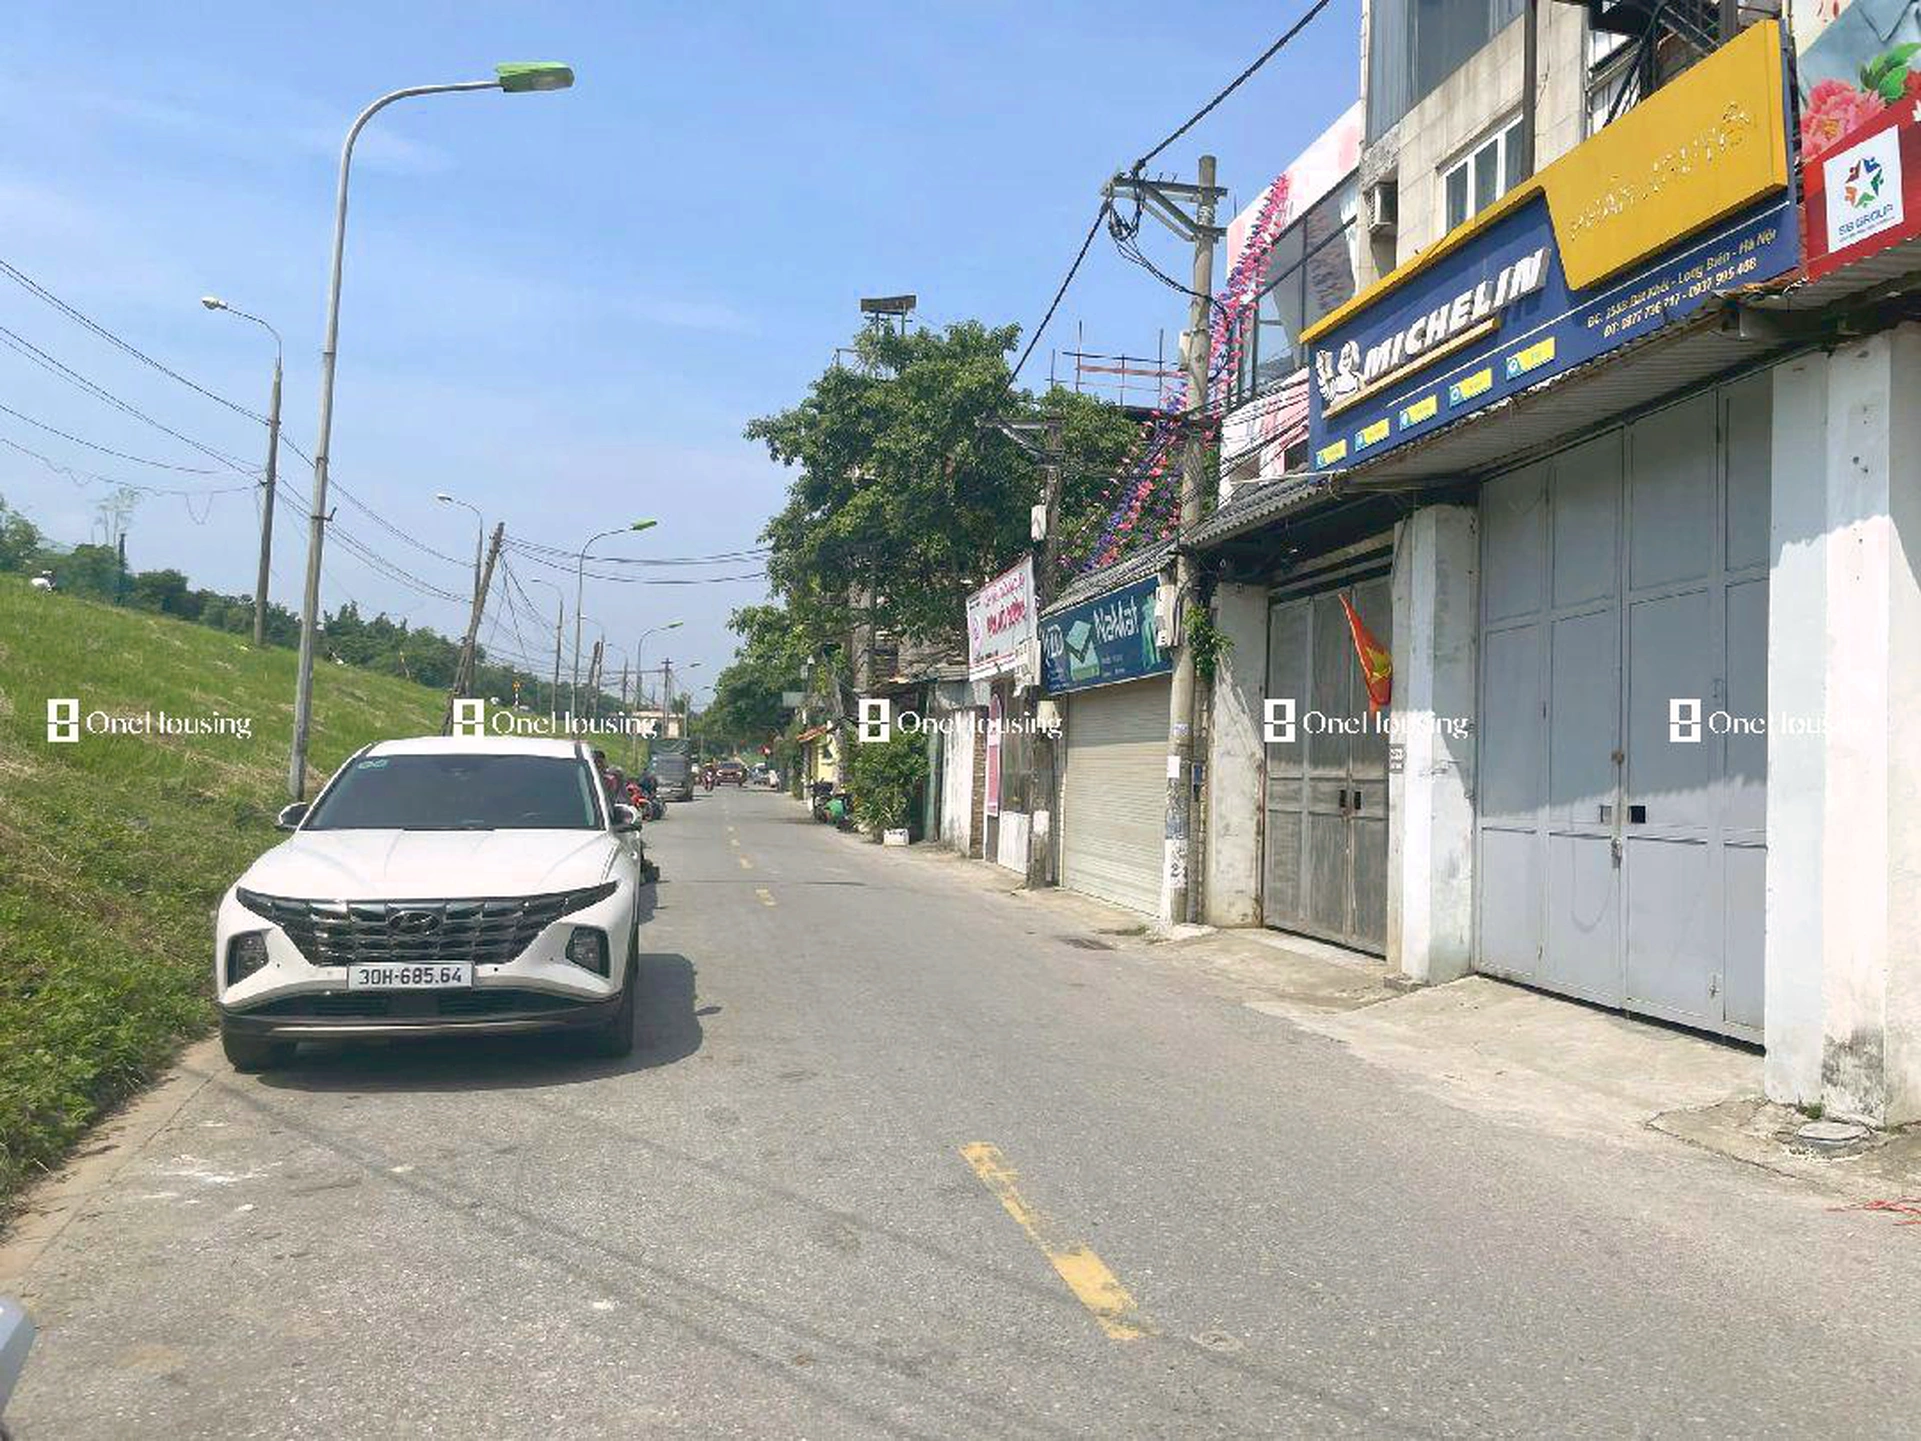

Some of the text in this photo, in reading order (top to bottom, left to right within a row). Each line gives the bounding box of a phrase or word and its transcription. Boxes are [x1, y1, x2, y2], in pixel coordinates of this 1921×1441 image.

[1855, 203, 1893, 228] GROUP
[1678, 265, 1703, 284] Long
[1364, 246, 1550, 385] MICHELIN
